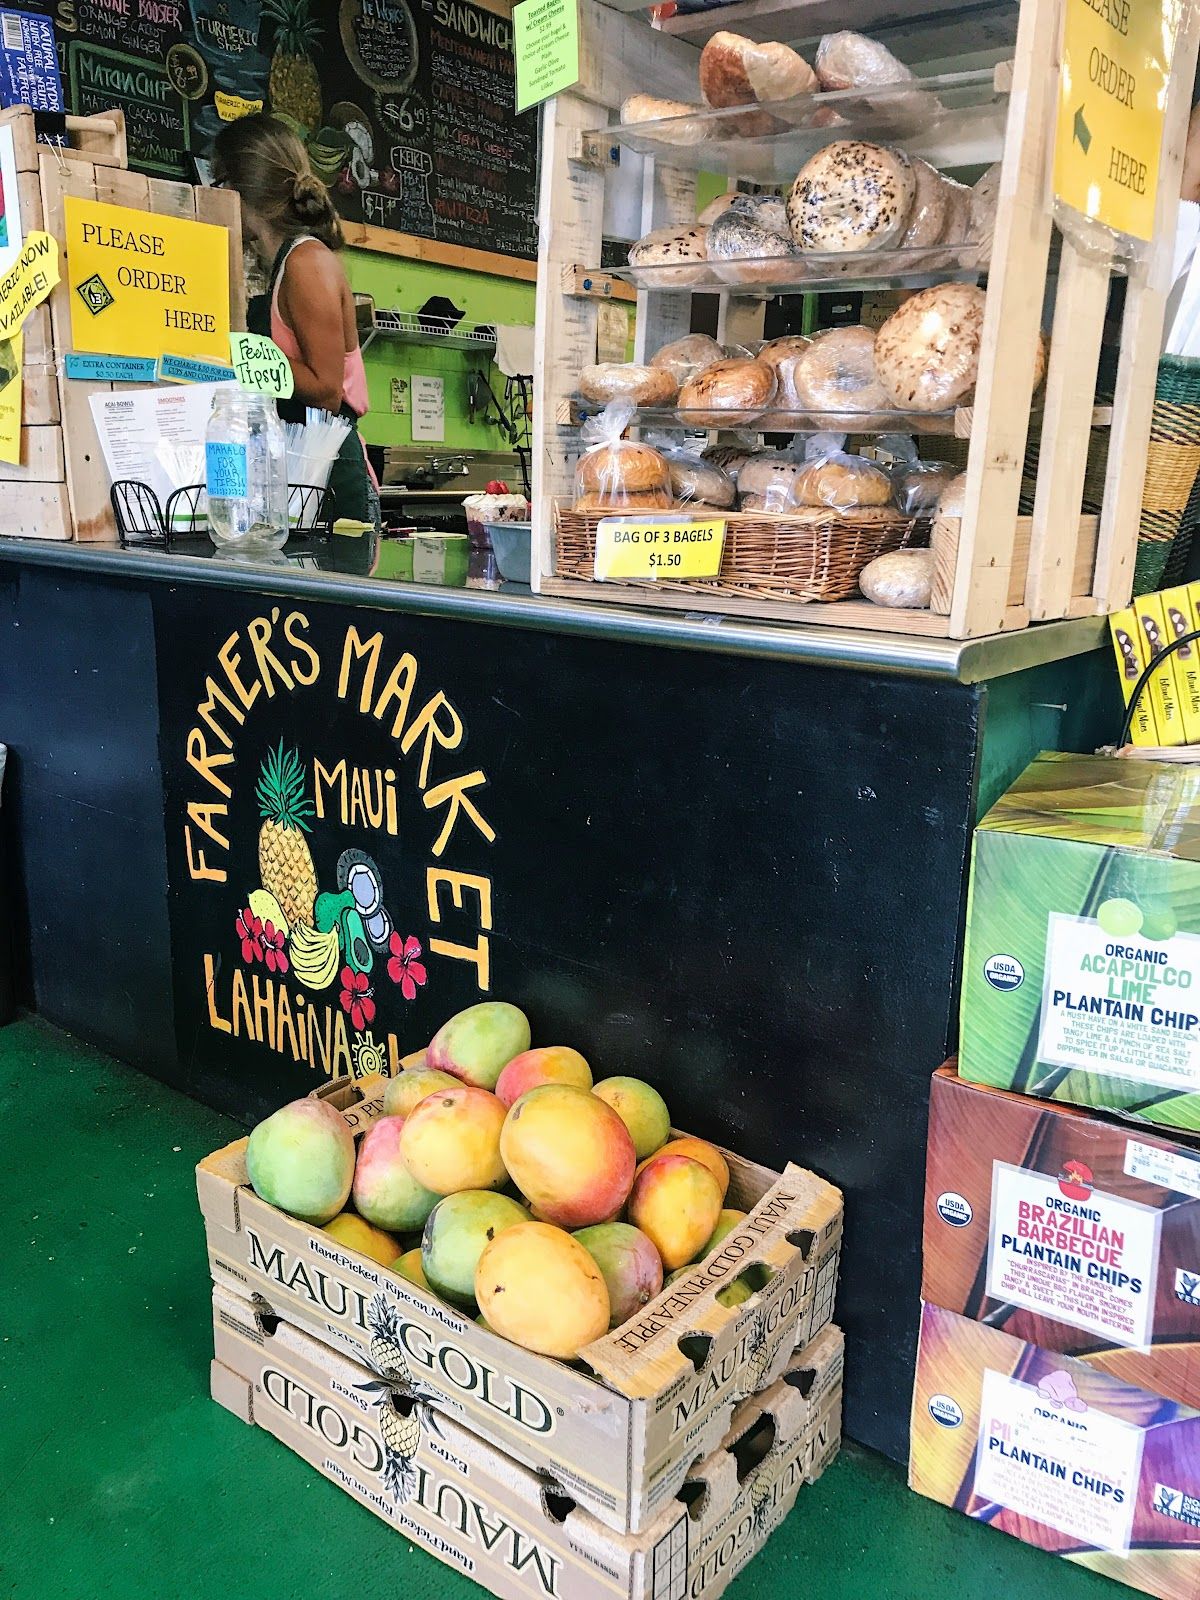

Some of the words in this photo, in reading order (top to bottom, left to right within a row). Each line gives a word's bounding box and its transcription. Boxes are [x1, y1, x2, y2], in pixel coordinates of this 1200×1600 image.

[80, 20, 116, 40] LEMON
[196, 16, 259, 47] TURMERIC
[1082, 0, 1131, 36] EASE
[29, 19, 42, 48] GLUTEN
[39, 20, 55, 73] NATURAL
[33, 48, 44, 69] FREE
[1088, 46, 1136, 110] ORDER
[1108, 146, 1147, 195] HERE
[20, 237, 49, 268] NOW
[82, 222, 165, 257] PLEASE
[117, 266, 187, 295] ORDER
[165, 309, 216, 333] HERE
[239, 338, 282, 362] Feelin
[82, 360, 106, 369] EXTRA
[106, 361, 145, 371] CONTAINER
[236, 361, 288, 392] Tipsy?
[208, 445, 246, 456] MAHALO
[218, 457, 236, 468] FOR
[215, 469, 240, 480] YOUR
[614, 531, 639, 543] BAG
[644, 531, 659, 543] OF
[663, 531, 669, 543] 3
[673, 528, 713, 543] BAGELS
[649, 553, 681, 567] $1.50
[185, 606, 320, 882] FARMER'S
[338, 624, 496, 991] MARKET
[993, 961, 1016, 974] USDA
[1105, 943, 1168, 965] ORGANIC
[989, 971, 1019, 984] ORGANIC
[1079, 953, 1192, 988] ACAPULCO
[1107, 977, 1157, 1005] LIME
[1053, 990, 1144, 1022] PLANTAIN
[1150, 1007, 1200, 1032] CHIP
[1067, 1011, 1086, 1020] MUST
[1127, 1022, 1148, 1032] WHITE
[1151, 1026, 1171, 1037] SAND
[1063, 1027, 1083, 1037] TANGY
[1086, 1032, 1101, 1041] LIME
[1119, 1038, 1140, 1048] PINCH
[1155, 1045, 1170, 1054] SEA
[1173, 1048, 1191, 1058] SALT
[1072, 1021, 1093, 1030] THESE
[1097, 1025, 1118, 1035] CHIPS
[1121, 1030, 1135, 1039] ARE
[1138, 1033, 1166, 1044] LOADED
[1169, 1040, 1186, 1048] WITH
[1057, 1043, 1085, 1055] DIPPING
[1100, 1051, 1108, 1059] IN
[1110, 1054, 1134, 1065] SALSA
[1075, 1038, 1097, 1049] SPICE
[1109, 1044, 1118, 1052] UP
[1127, 1048, 1153, 1059] LITTLE
[1174, 1057, 1189, 1066] TRY
[748, 1191, 796, 1234] MAUI
[941, 1207, 968, 1221] ORGANIC
[944, 1198, 965, 1212] USDA
[1045, 1196, 1102, 1222] ORGANIC
[1018, 1201, 1125, 1250] BRAZILIAN
[707, 1235, 754, 1277] GOLD
[1017, 1219, 1123, 1269] BARBECUE
[1001, 1234, 1082, 1273] PLANTAIN
[1087, 1262, 1143, 1294] CHIPS
[1010, 1269, 1026, 1279] THIS
[1027, 1275, 1051, 1289] UNIQUE
[1027, 1258, 1058, 1274] INSPIRED
[1060, 1268, 1068, 1276] BY
[1071, 1272, 1083, 1283] THE
[1086, 1278, 1113, 1293] FAMOUS
[384, 1277, 411, 1302] Ripe
[413, 1299, 429, 1315] on
[1001, 1281, 1017, 1291] CHIP
[1018, 1288, 1033, 1297] WILL
[1034, 1293, 1055, 1305] LEAVE
[1057, 1301, 1074, 1311] YOUR
[1077, 1307, 1099, 1320] MOUTH
[1003, 1274, 1023, 1285] TANGY
[1032, 1284, 1054, 1297] SWEET
[1063, 1294, 1079, 1305] THIS
[1080, 1300, 1099, 1312] LATIN
[1101, 1306, 1135, 1326] INSPIRED
[1072, 1281, 1079, 1289] IN
[1109, 1293, 1133, 1308] COMES
[613, 1273, 712, 1354] PINEAPPLE
[247, 1231, 369, 1331] MAUI
[399, 1322, 553, 1435] GOLD
[327, 1324, 363, 1349] Extra
[672, 1337, 749, 1435] MAUI
[767, 1266, 816, 1333] GOLD
[262, 1370, 383, 1470] GOLD
[935, 1400, 956, 1414] USDA
[331, 1380, 368, 1411] Sweet
[430, 1441, 468, 1475] Extra
[989, 1436, 1067, 1480] PLANTAIN
[1072, 1471, 1125, 1503] CHIPS
[354, 1481, 368, 1496] on
[370, 1493, 393, 1517] Ripe
[412, 1463, 561, 1600] MAUI
[692, 1515, 753, 1600] GOLD
